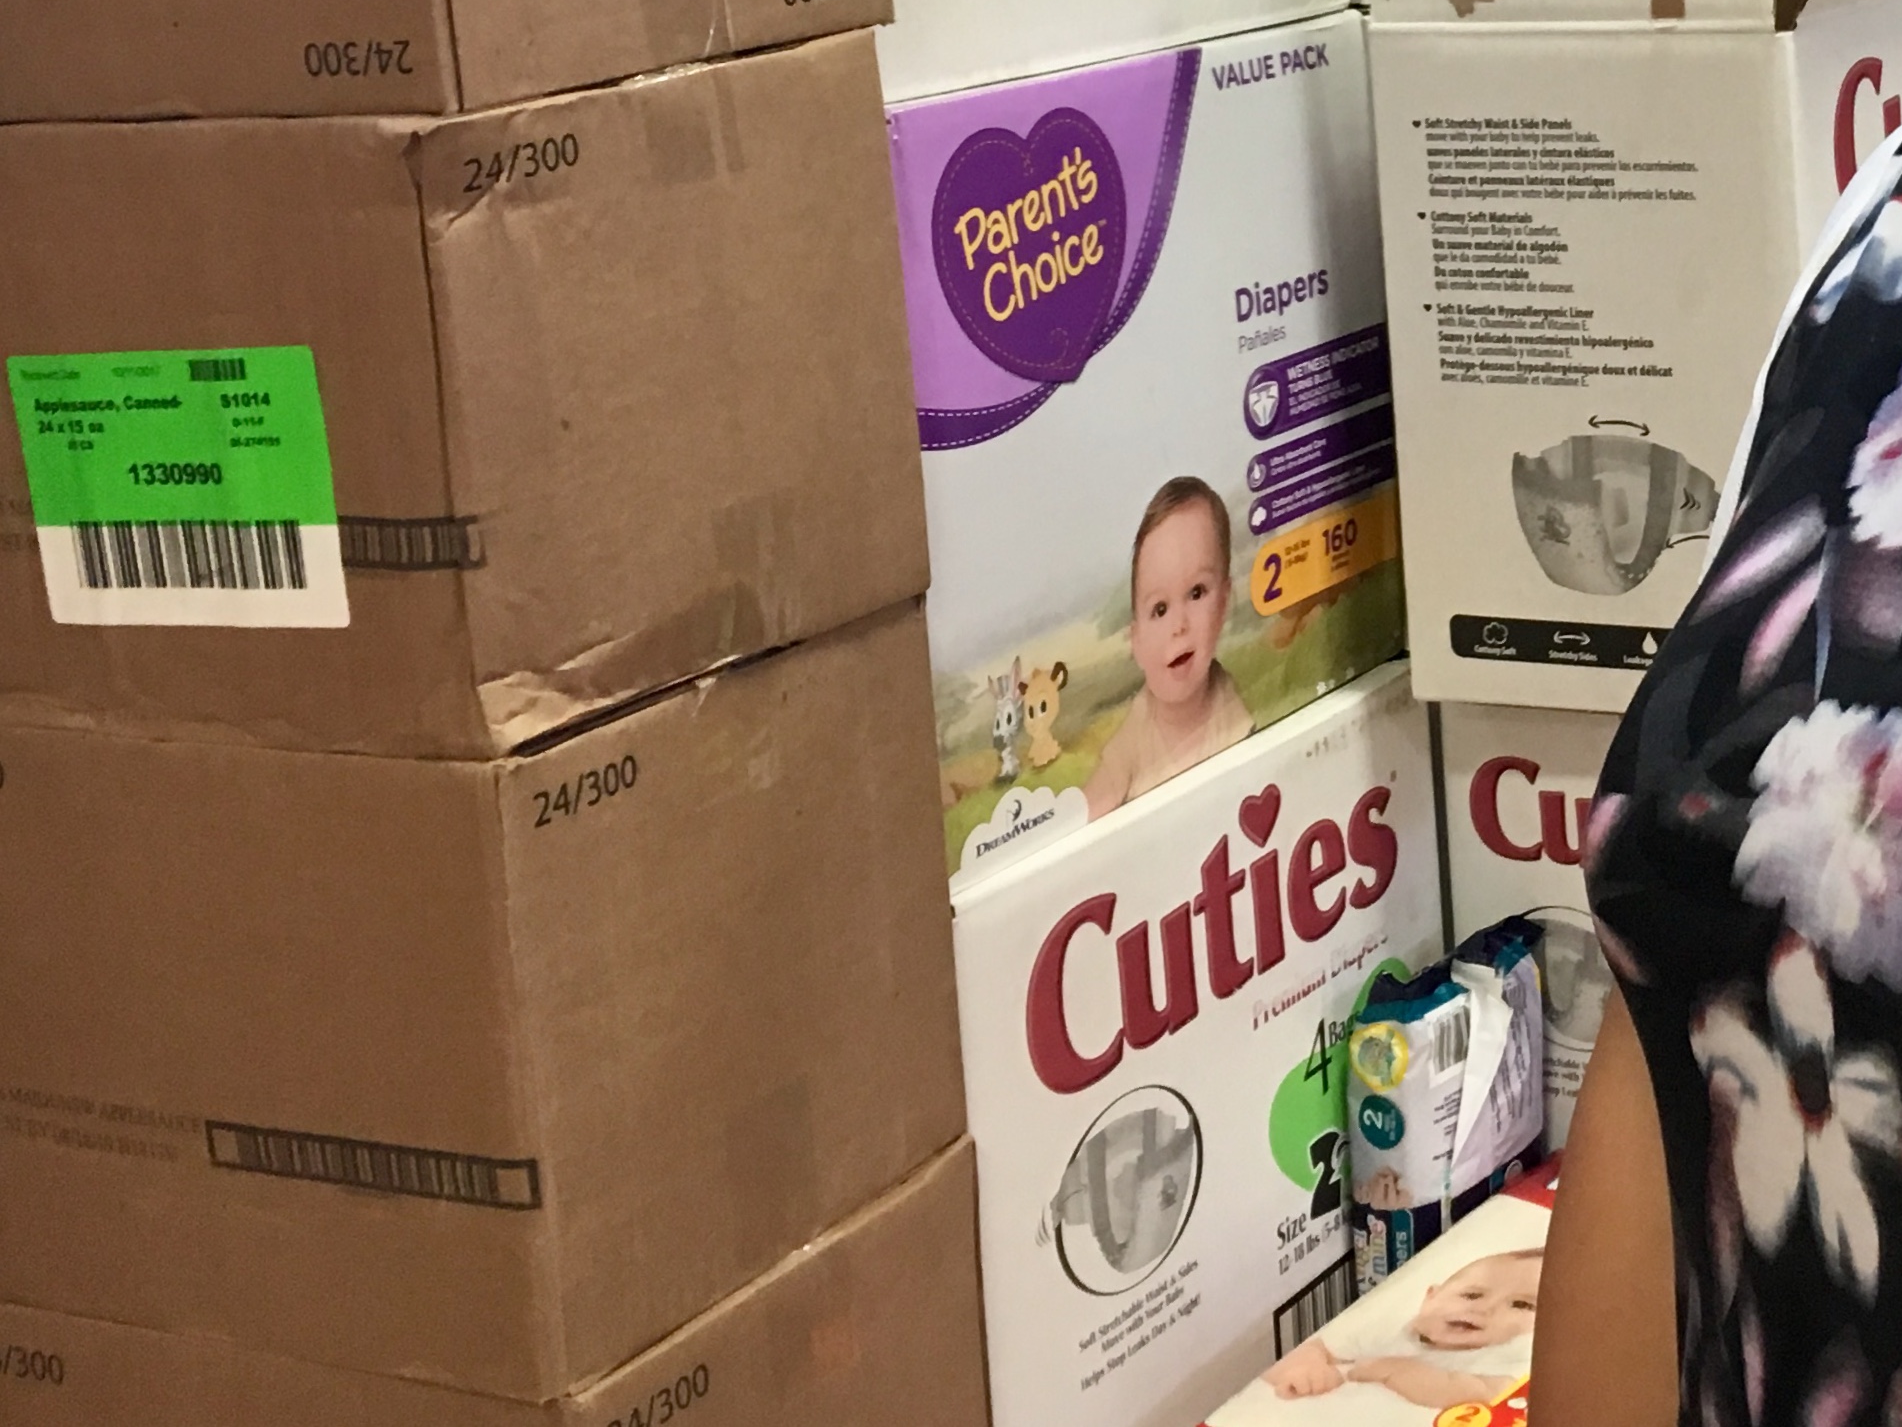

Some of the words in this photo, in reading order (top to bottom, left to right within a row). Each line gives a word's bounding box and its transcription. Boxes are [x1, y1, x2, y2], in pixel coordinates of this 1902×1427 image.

[304, 40, 413, 78] 24/300
[1212, 54, 1276, 91] VALUE
[1280, 43, 1330, 75] PACK
[1425, 118, 1443, 129] Soft
[1445, 118, 1482, 131] Stretchy
[1484, 118, 1509, 129] Waist
[1520, 118, 1540, 129] Side
[1541, 118, 1572, 130] Panels
[461, 133, 581, 195] 24/300
[953, 146, 1099, 270] Parent's
[1467, 211, 1487, 223] Soft
[1235, 269, 1330, 323] Diapers
[1436, 303, 1455, 314] Soft
[1465, 304, 1495, 315] Gentle
[1569, 307, 1594, 318] Liner
[1238, 325, 1287, 354] Pañales
[128, 462, 222, 485] 1330990
[1263, 552, 1283, 603] 2
[1322, 518, 1358, 556] 160
[533, 754, 640, 830] 24/300
[1025, 783, 1399, 1095] Cuties
[1304, 1018, 1332, 1096] 4
[1363, 1108, 1383, 1129] 2
[1277, 1213, 1307, 1250] Size
